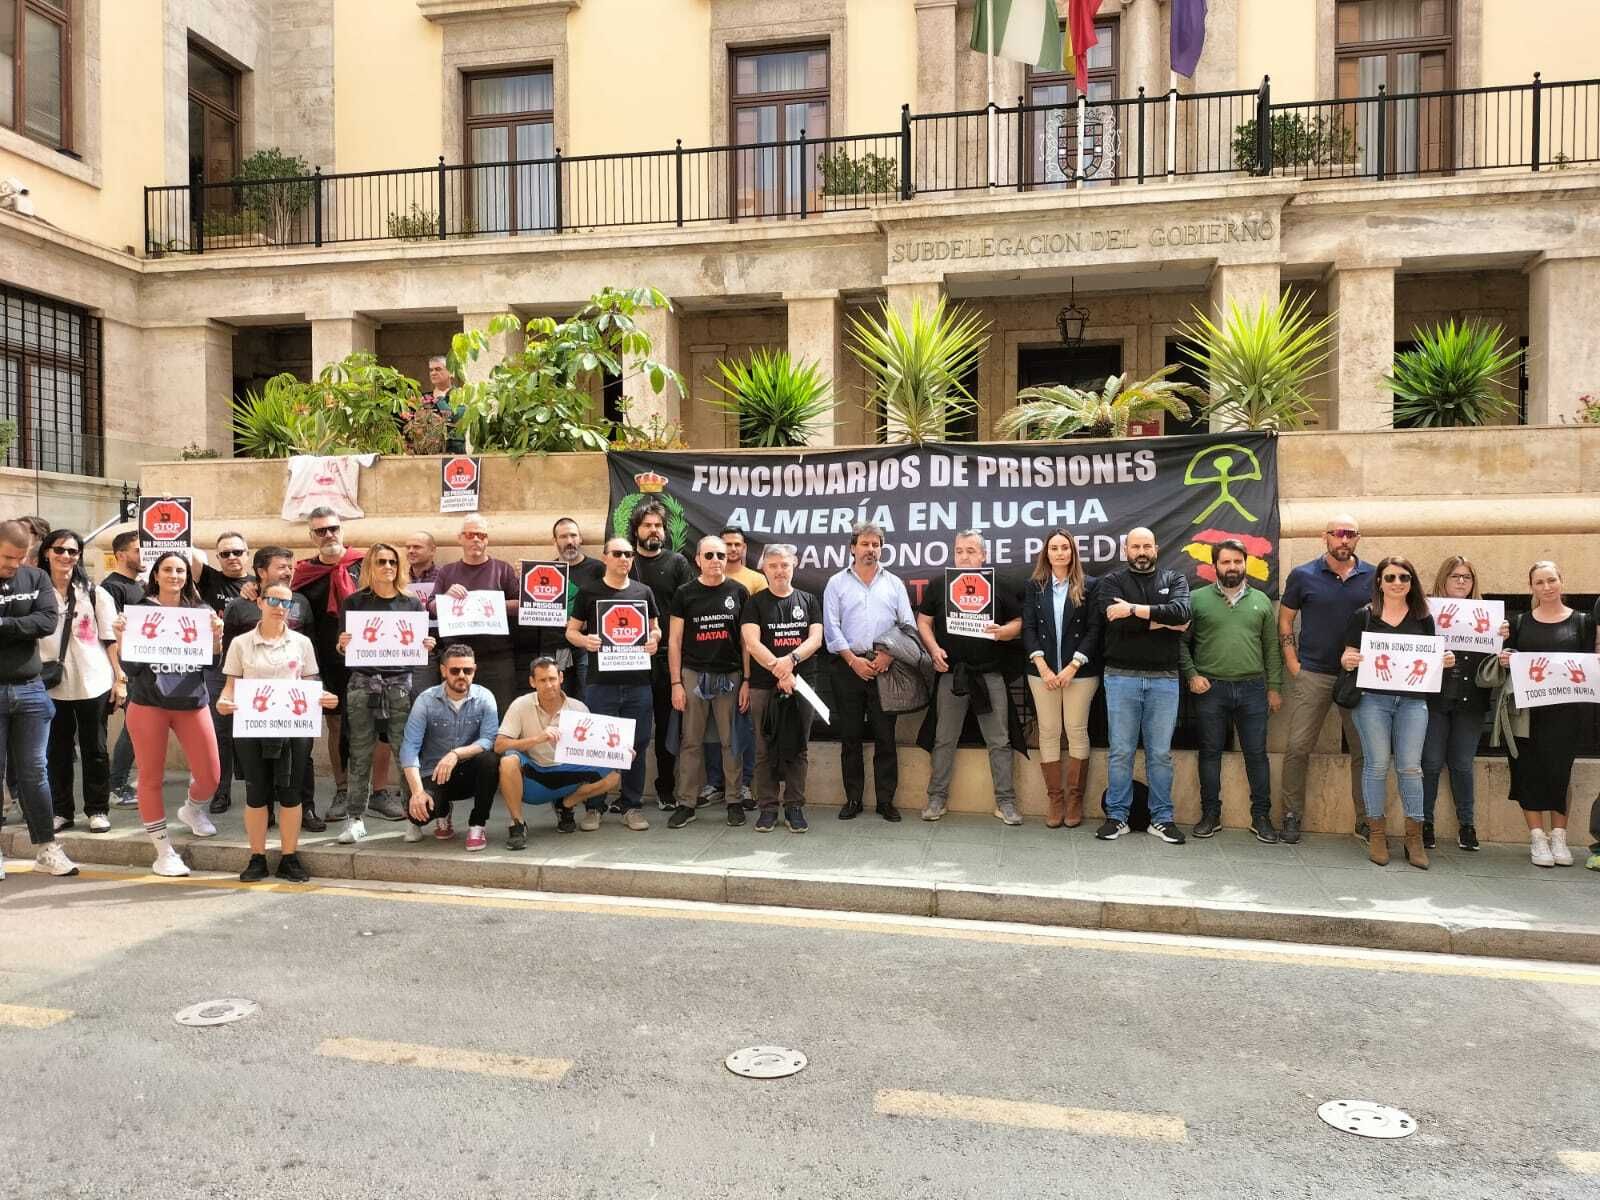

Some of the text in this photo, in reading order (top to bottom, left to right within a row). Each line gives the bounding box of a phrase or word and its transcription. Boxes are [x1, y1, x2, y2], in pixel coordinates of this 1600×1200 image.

[892, 220, 1274, 262] SUBDELEGACION DEL GOBIERNO
[691, 450, 1157, 497] FUNCIONARIOS DE PRISIONES
[726, 497, 1108, 534] ALMERÍA EN LUCHA
[153, 522, 181, 530] STOP
[534, 585, 558, 593] STOP
[612, 627, 638, 635] STOP
[696, 631, 728, 640] MATAR
[1370, 640, 1436, 653] TODOS SOMOS NURIA
[1451, 635, 1472, 644] SOMOS
[1474, 637, 1494, 647] NURIA
[133, 645, 203, 656] TODOS SOMOS NURIA
[356, 649, 421, 659] TODOS SOMOS NURIA
[1526, 686, 1595, 700] TODOS SOMOS NURIA
[245, 719, 313, 730] TODOS SOMOS NURIA
[566, 747, 625, 762] TODOS SOMOS NURIA
